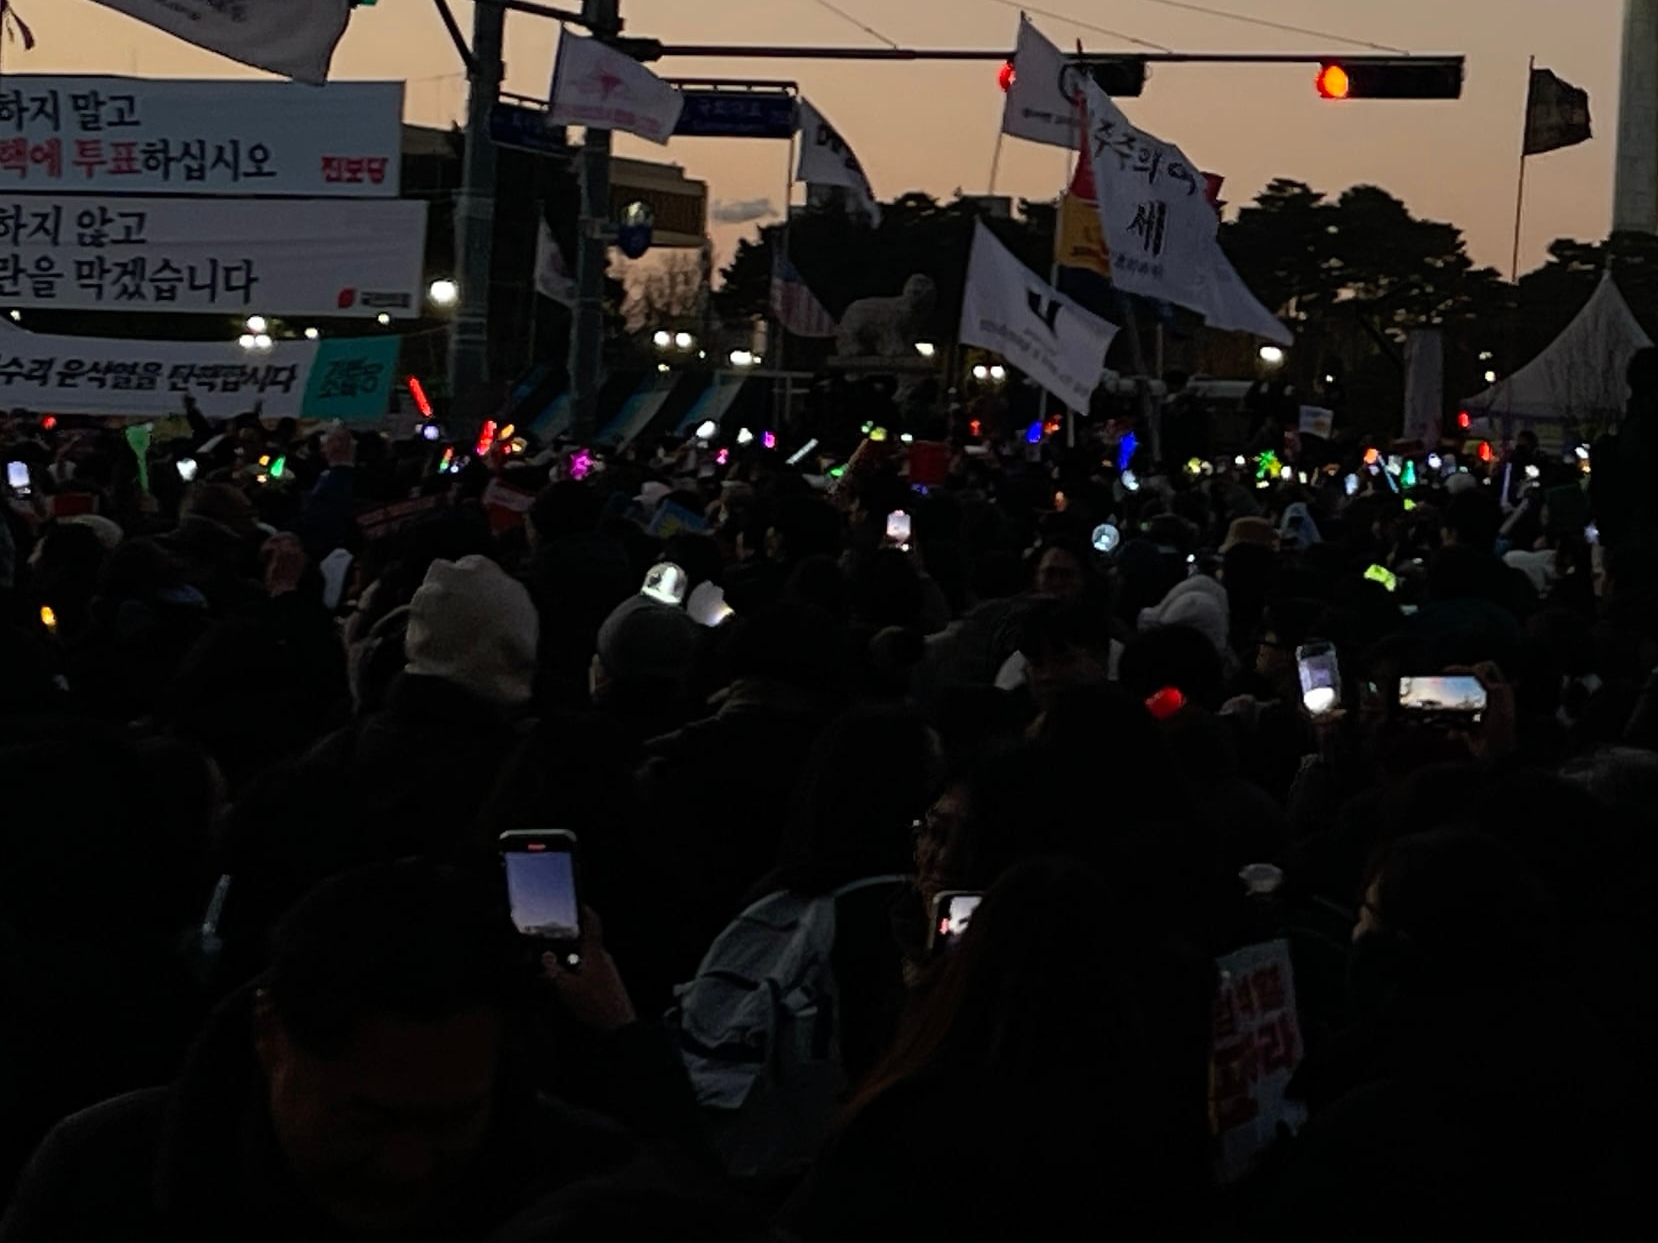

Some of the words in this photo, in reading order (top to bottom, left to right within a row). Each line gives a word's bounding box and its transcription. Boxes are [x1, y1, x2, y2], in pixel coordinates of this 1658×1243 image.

[0, 89, 60, 132] 하지
[72, 91, 141, 132] 말고
[73, 138, 277, 181] 투표하십시오
[321, 157, 389, 183] 진보당
[0, 205, 62, 247] 하지
[77, 206, 147, 248] 않고
[75, 256, 258, 304] 막겠습니다
